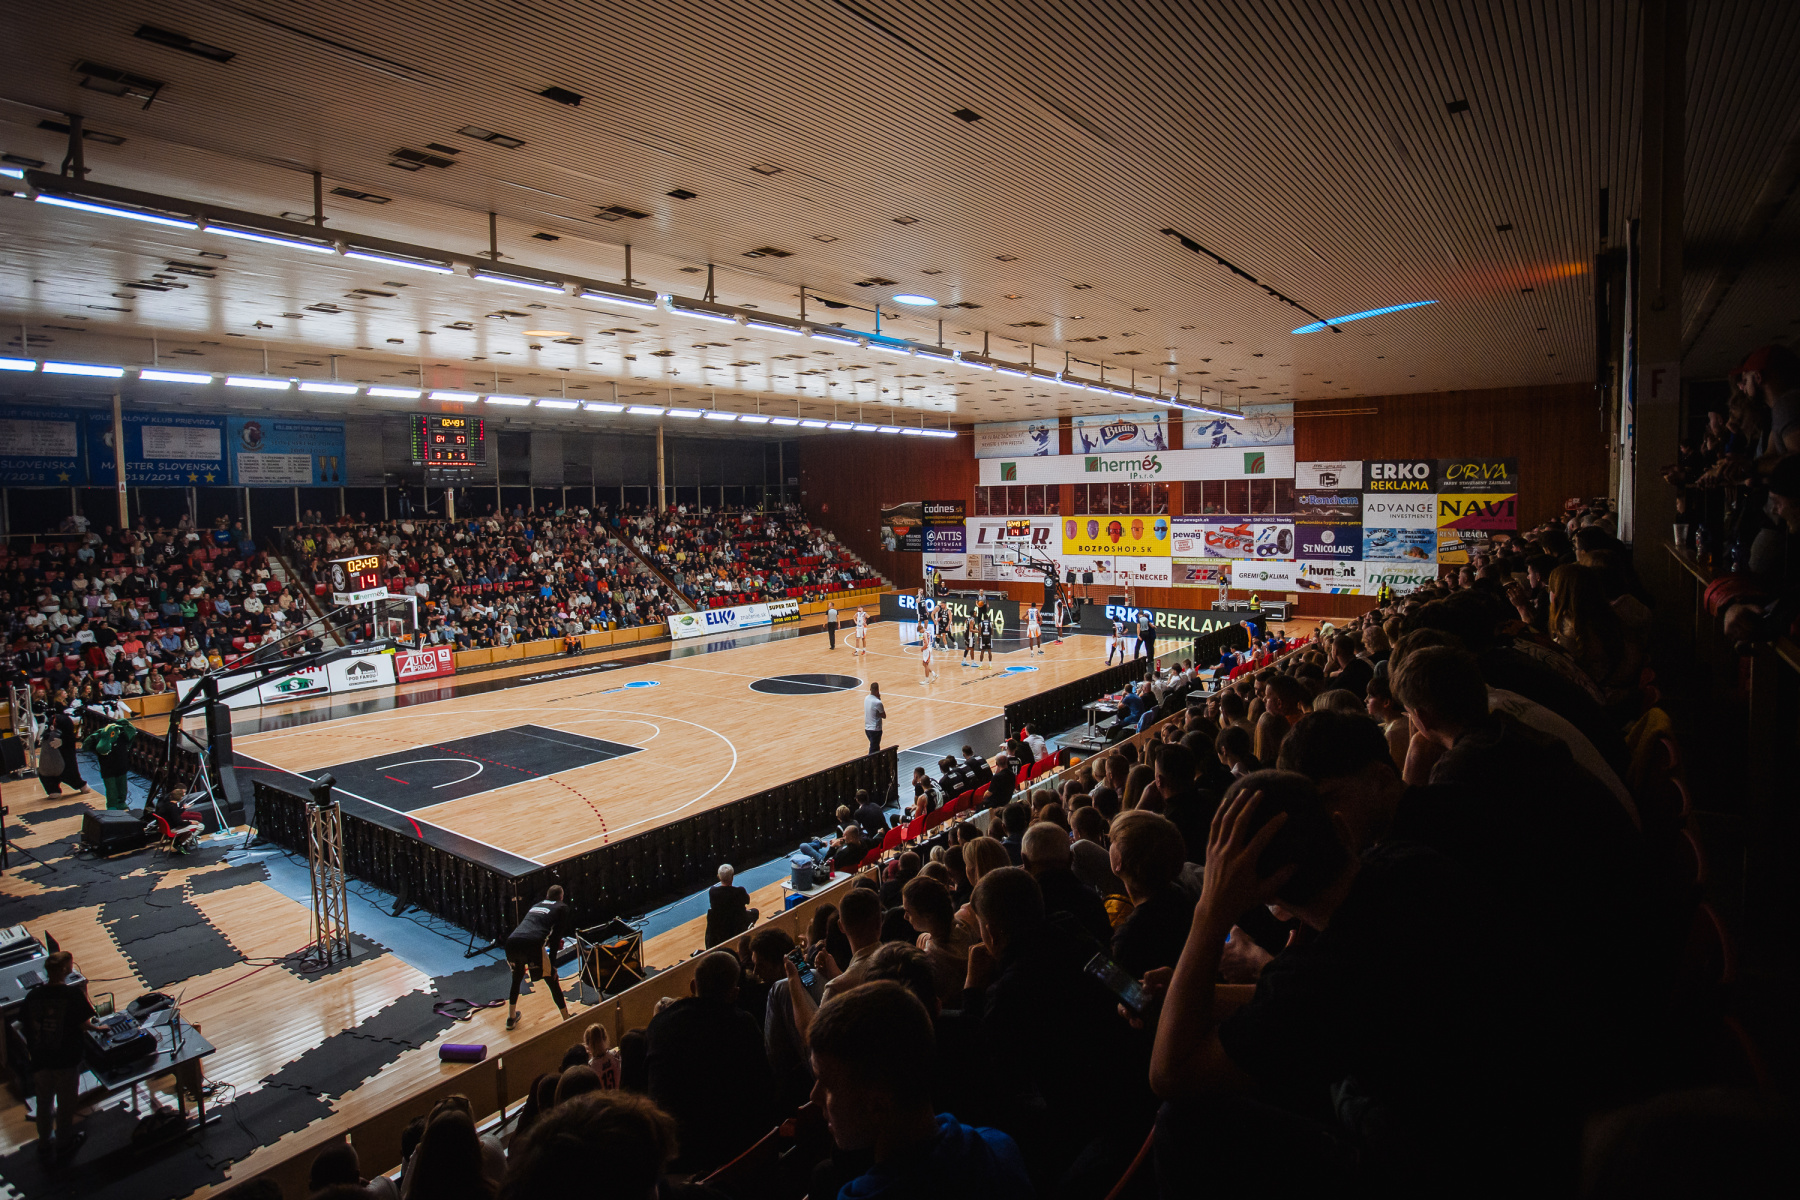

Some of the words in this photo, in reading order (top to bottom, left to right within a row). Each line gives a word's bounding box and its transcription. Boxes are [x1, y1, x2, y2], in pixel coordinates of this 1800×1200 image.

[1652, 369, 1666, 398] F
[21, 410, 70, 419] PRIEVIDZA
[436, 435, 446, 443] 64
[456, 436, 466, 444] 57
[0, 461, 77, 469] SLOVENSKA
[101, 462, 154, 470] MASTER
[158, 463, 221, 471] SLOVENSKA
[1099, 455, 1162, 473] hermés
[1371, 463, 1430, 479] ERKO
[1446, 463, 1508, 480] ORVA
[125, 473, 180, 481] 018/2019
[120, 483, 127, 492] A
[1371, 481, 1429, 490] REKLAMA
[1309, 495, 1359, 505] Ronchem
[1368, 503, 1433, 513] ADVANCE
[1440, 501, 1515, 517] NAVI
[936, 531, 962, 541] ATTIS
[1173, 531, 1201, 540] pewag
[1440, 530, 1488, 538] RESTAURÁCIA
[348, 557, 378, 572] 02:49
[361, 574, 377, 589] 14
[705, 610, 735, 625] ELKO
[401, 654, 434, 673] AUTO
[413, 663, 435, 671] PRIMA
